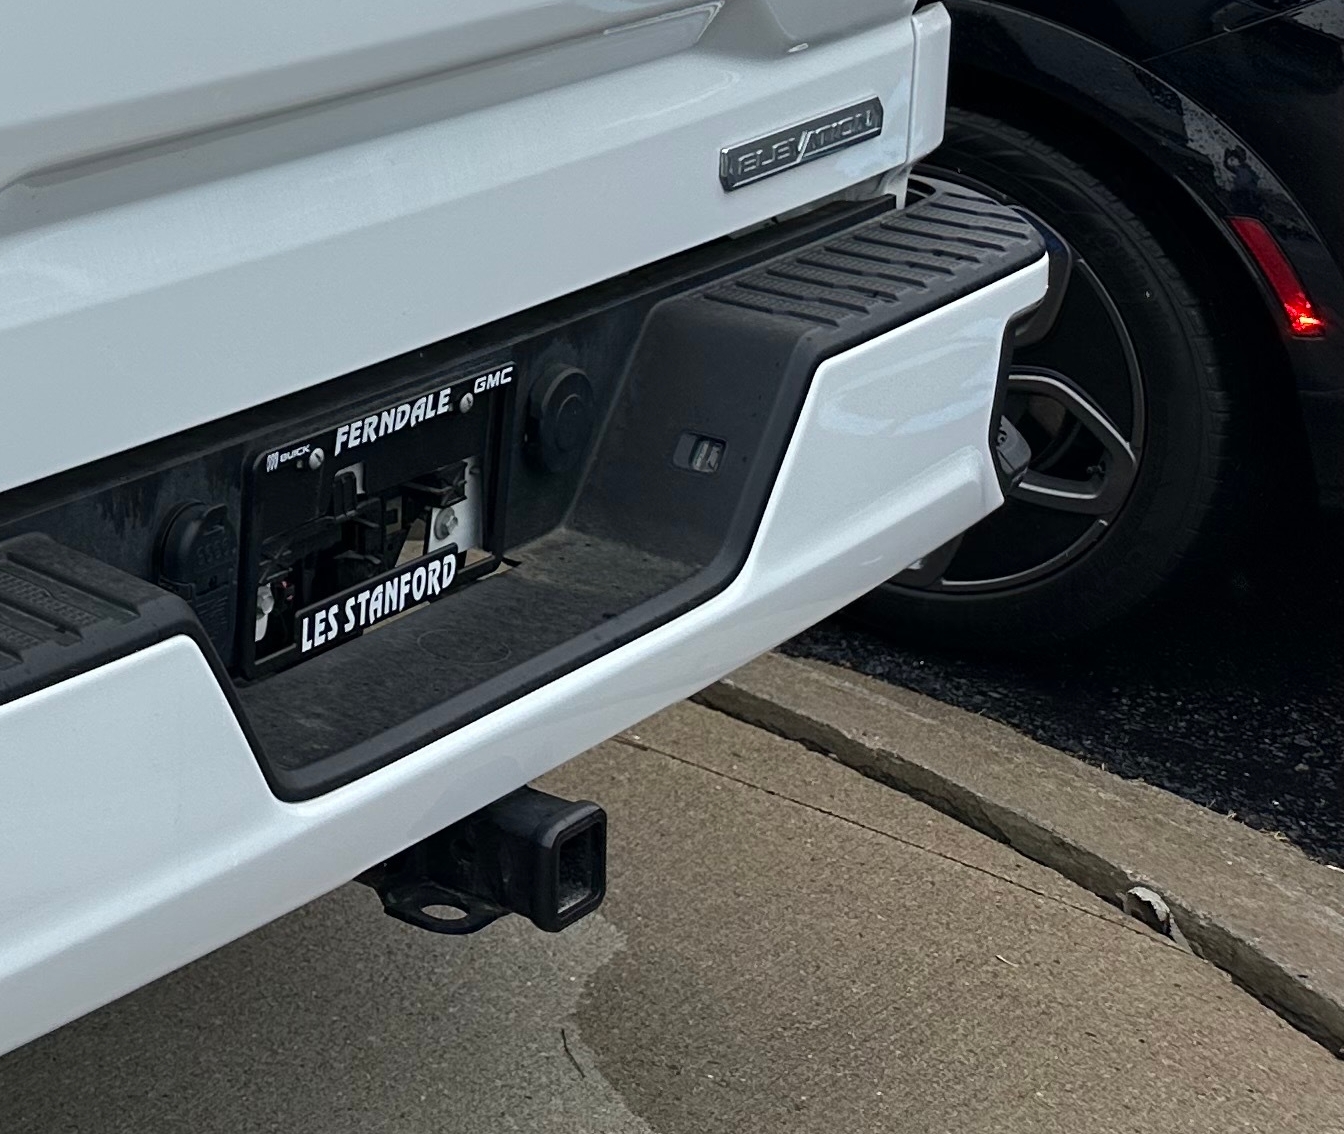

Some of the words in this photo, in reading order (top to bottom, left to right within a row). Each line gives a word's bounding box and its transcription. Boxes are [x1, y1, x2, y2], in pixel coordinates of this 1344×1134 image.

[736, 108, 879, 176] ELEVATION
[280, 443, 310, 463] BUICK
[334, 387, 451, 457] FERNDALE
[473, 366, 513, 394] GMC
[301, 604, 339, 652] LES
[344, 553, 456, 633] STANFORD
